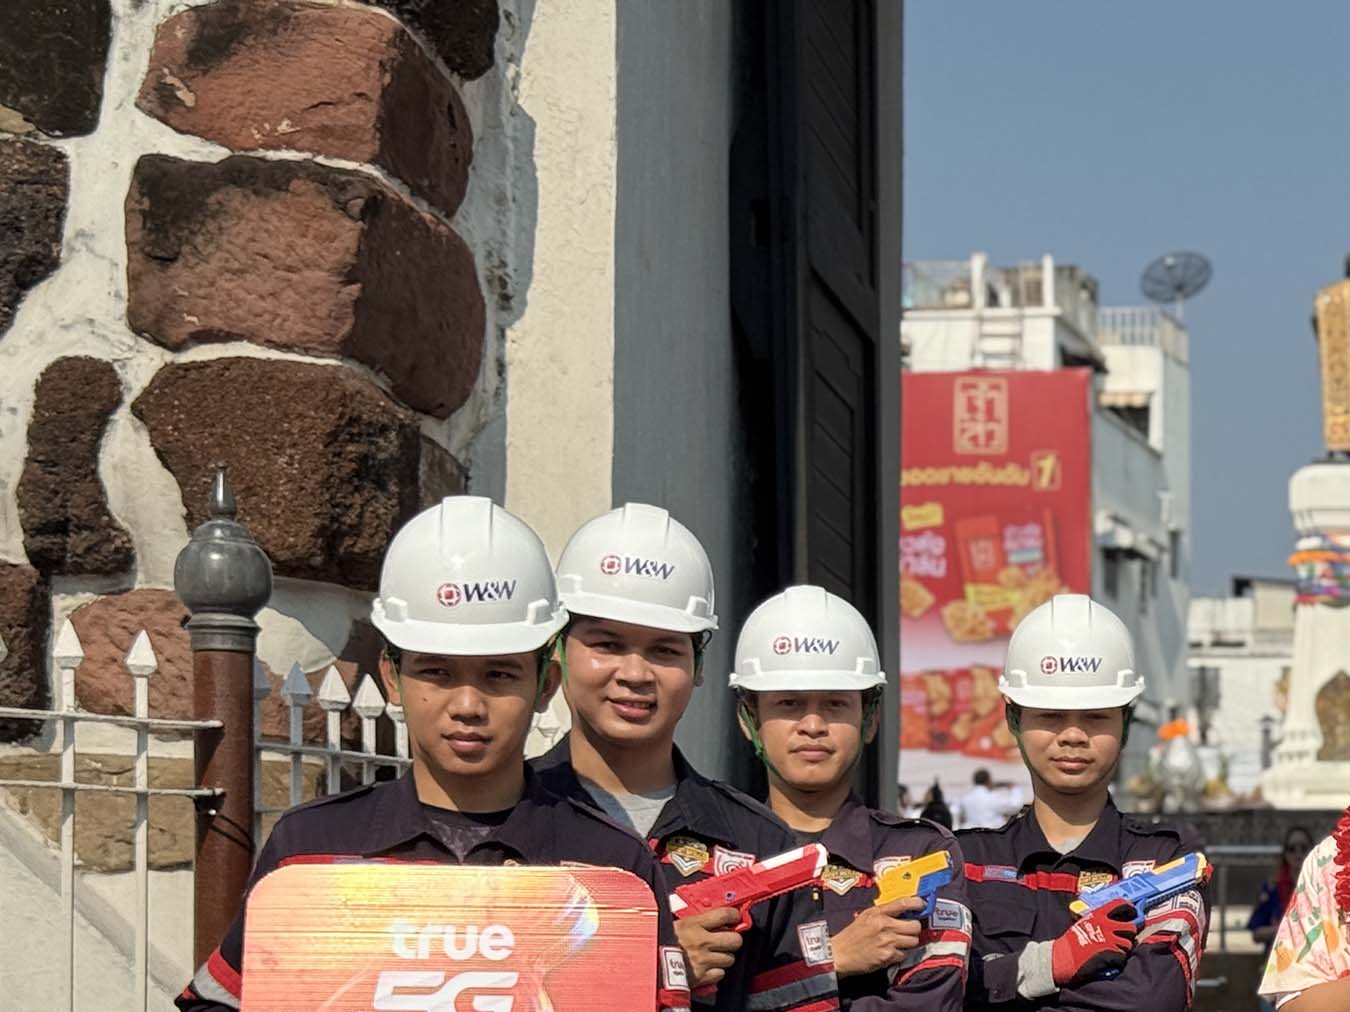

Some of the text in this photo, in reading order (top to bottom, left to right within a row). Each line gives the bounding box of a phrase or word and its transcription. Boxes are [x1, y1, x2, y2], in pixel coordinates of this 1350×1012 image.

[1037, 453, 1057, 489] 1
[624, 556, 675, 581] W&W
[463, 579, 517, 602] W&W
[794, 637, 840, 656] W&W
[1060, 657, 1103, 673] W&W
[389, 923, 515, 961] true
